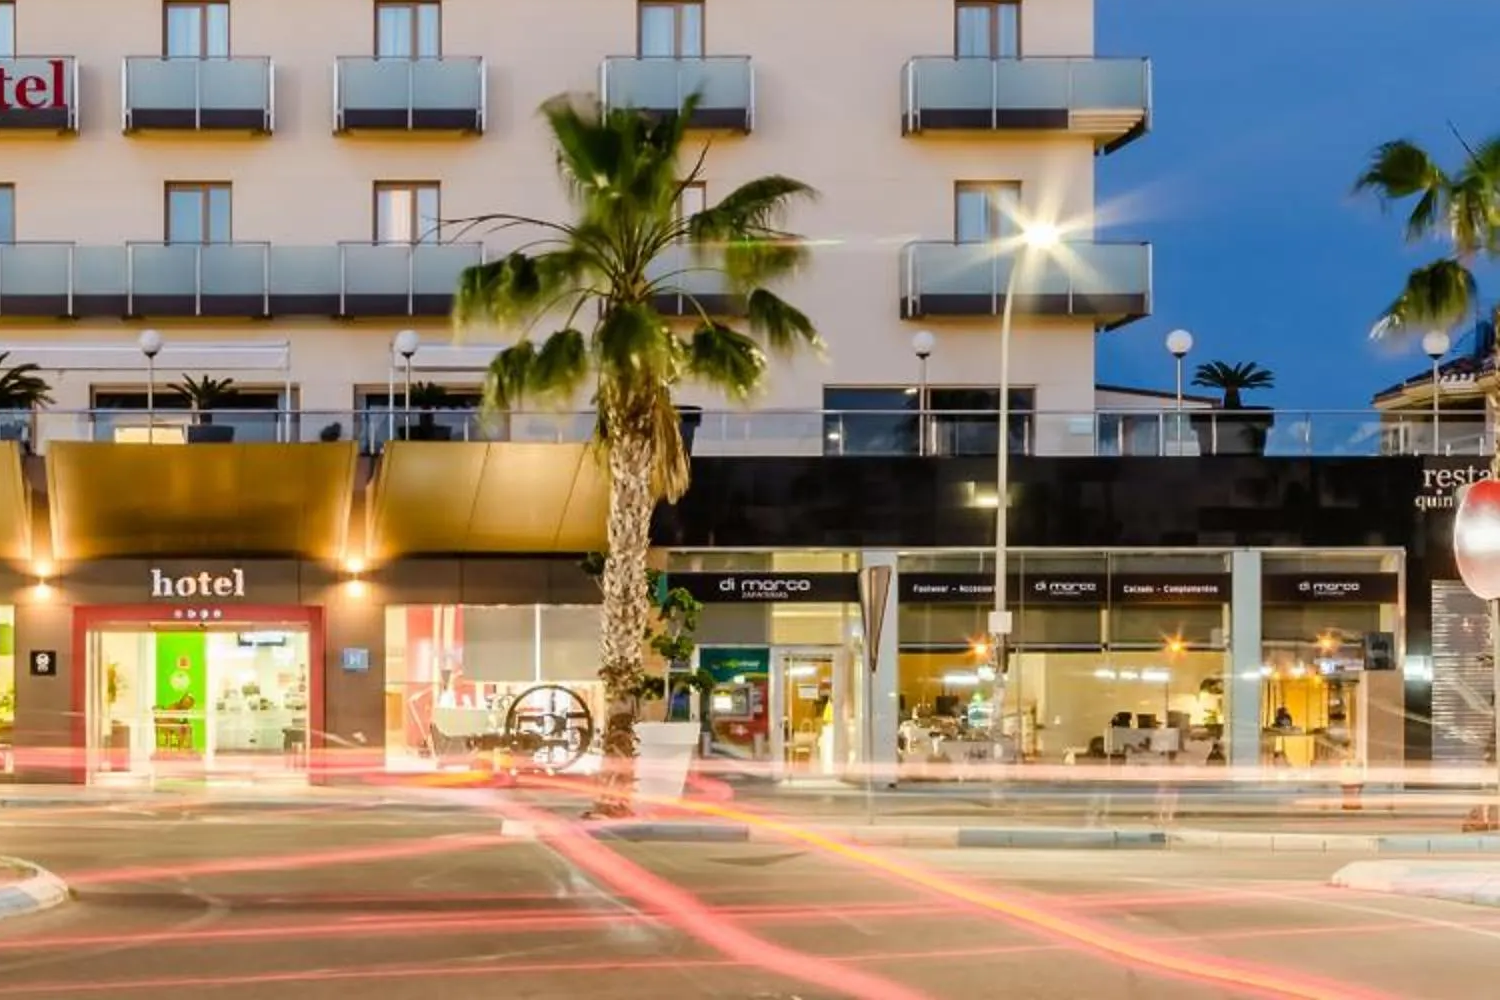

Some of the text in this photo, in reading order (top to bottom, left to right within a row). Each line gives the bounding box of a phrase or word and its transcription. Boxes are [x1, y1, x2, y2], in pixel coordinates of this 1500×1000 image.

[150, 568, 245, 596] hotel
[719, 577, 811, 591] di marco
